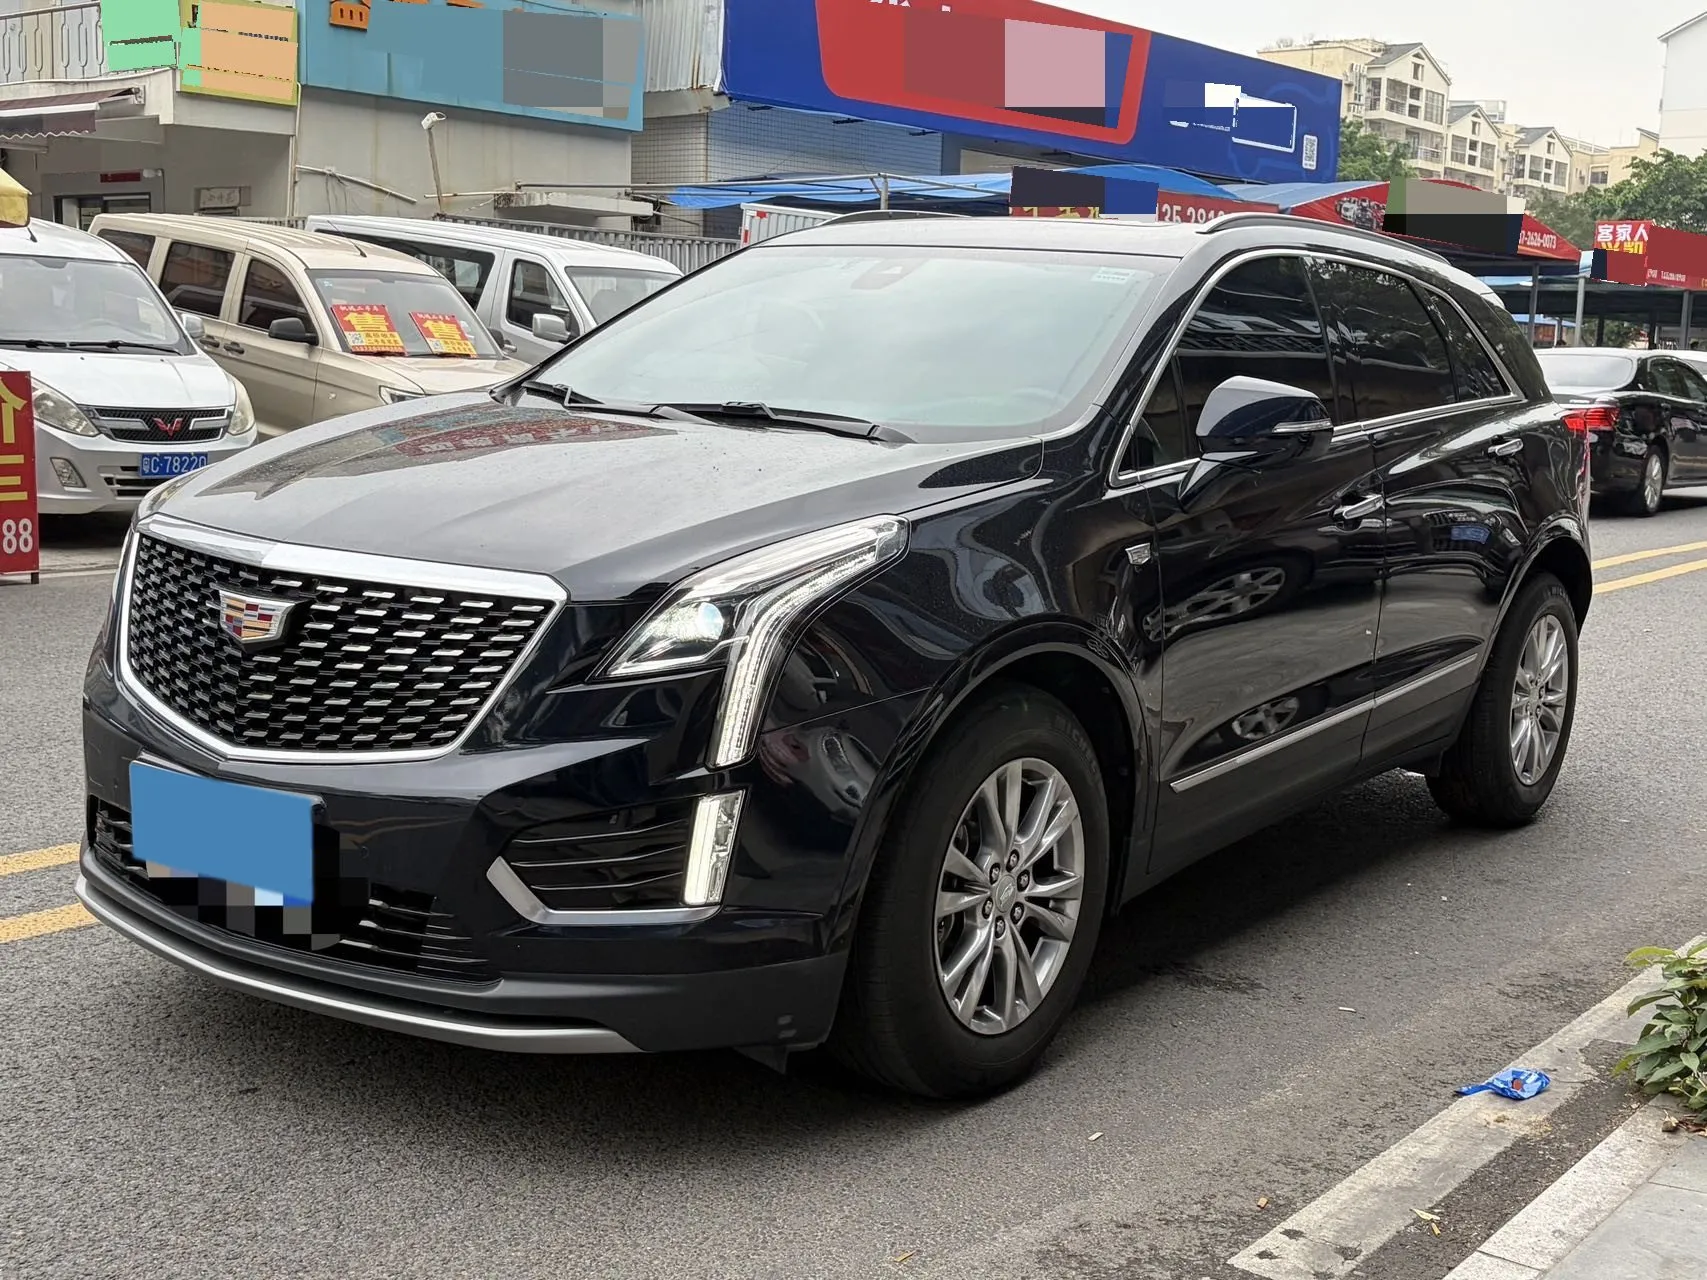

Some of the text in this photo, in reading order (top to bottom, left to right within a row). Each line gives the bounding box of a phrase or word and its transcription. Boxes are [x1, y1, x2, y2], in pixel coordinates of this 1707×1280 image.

[1597, 224, 1649, 242] 客家人
[343, 312, 389, 332] 售
[422, 320, 462, 340] 售
[2, 518, 33, 554] 88
